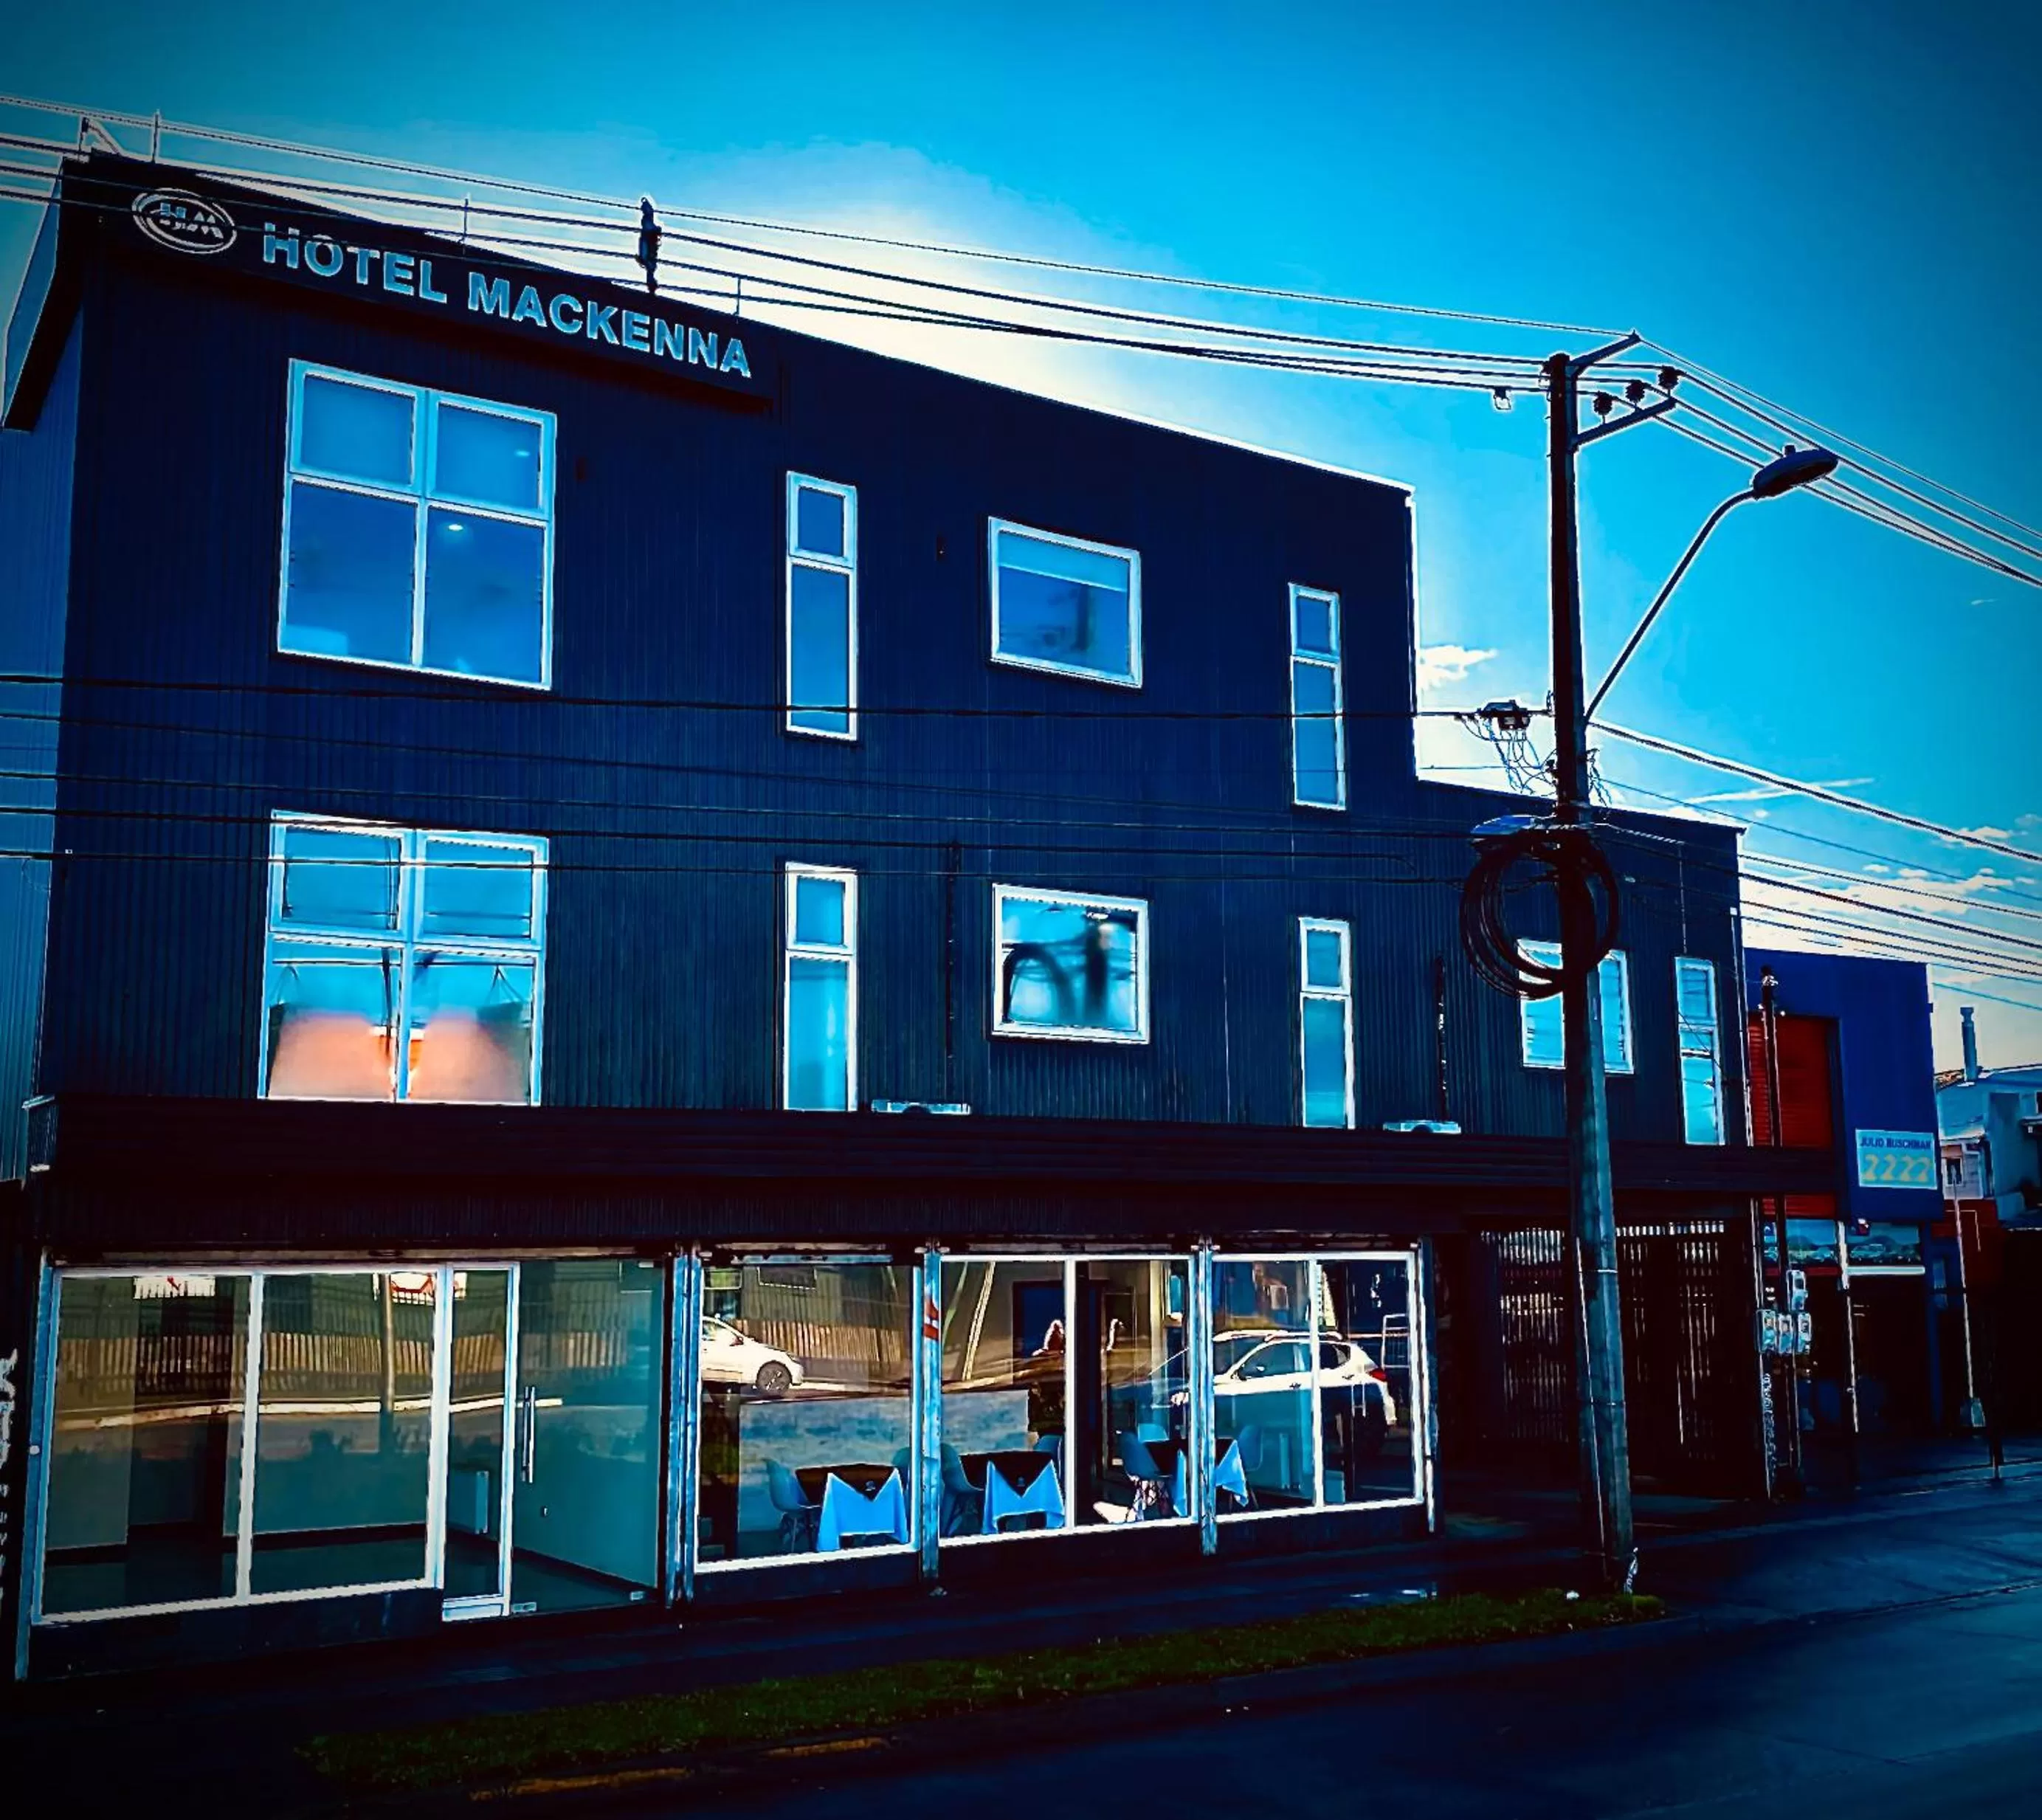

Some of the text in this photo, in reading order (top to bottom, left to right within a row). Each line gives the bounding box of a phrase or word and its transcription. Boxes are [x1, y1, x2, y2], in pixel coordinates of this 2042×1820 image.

[262, 222, 753, 379] HOTEL MACKENNA
[1860, 1137, 1884, 1148] JULIO
[1863, 1154, 1932, 1183] 2222
